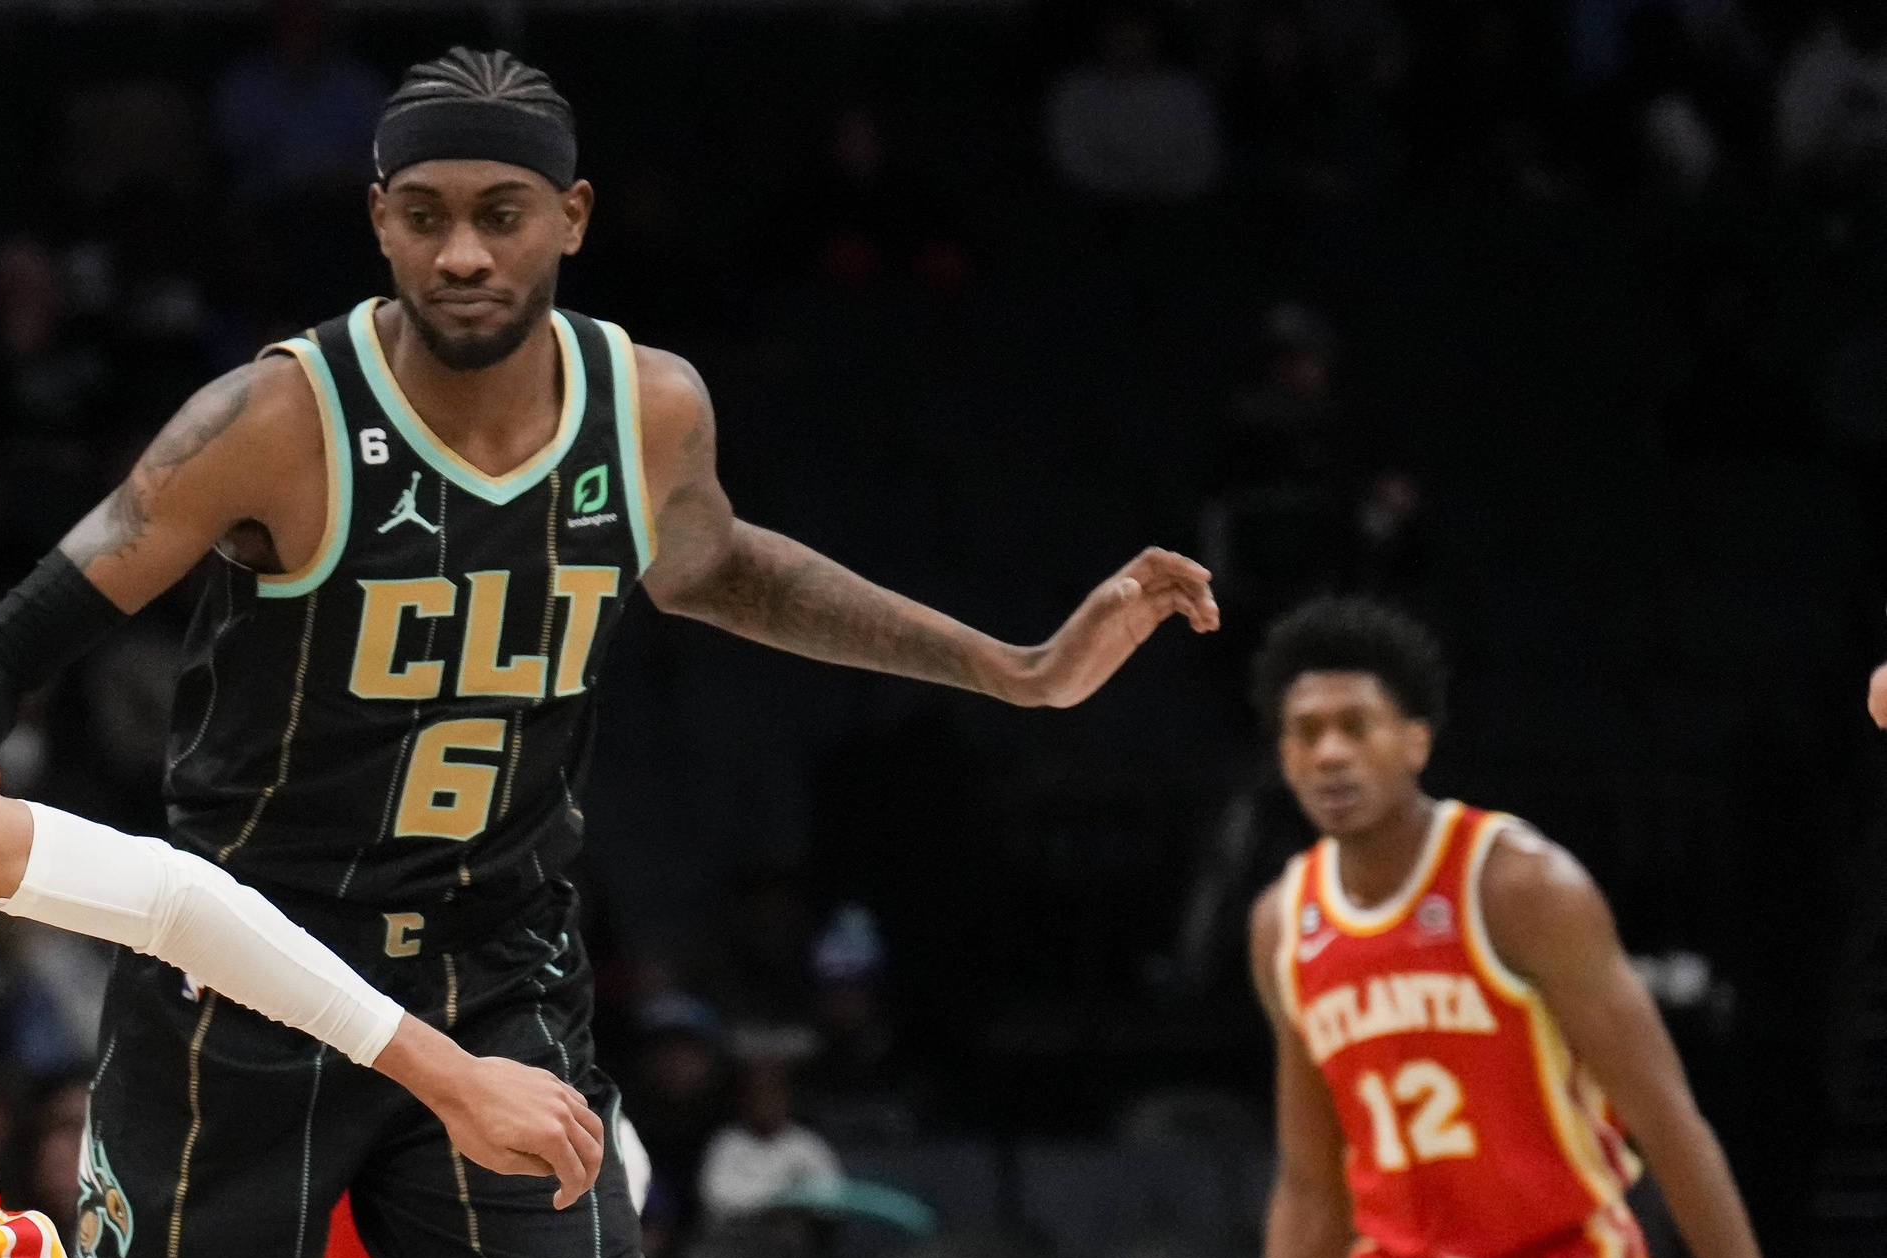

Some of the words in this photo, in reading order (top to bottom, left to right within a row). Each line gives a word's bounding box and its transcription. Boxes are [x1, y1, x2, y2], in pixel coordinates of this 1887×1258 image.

[359, 428, 390, 465] 6
[349, 566, 620, 699] CLT
[395, 718, 507, 840] 6
[1307, 973, 1498, 1064] ATLANTA
[1358, 1059, 1478, 1171] 12
